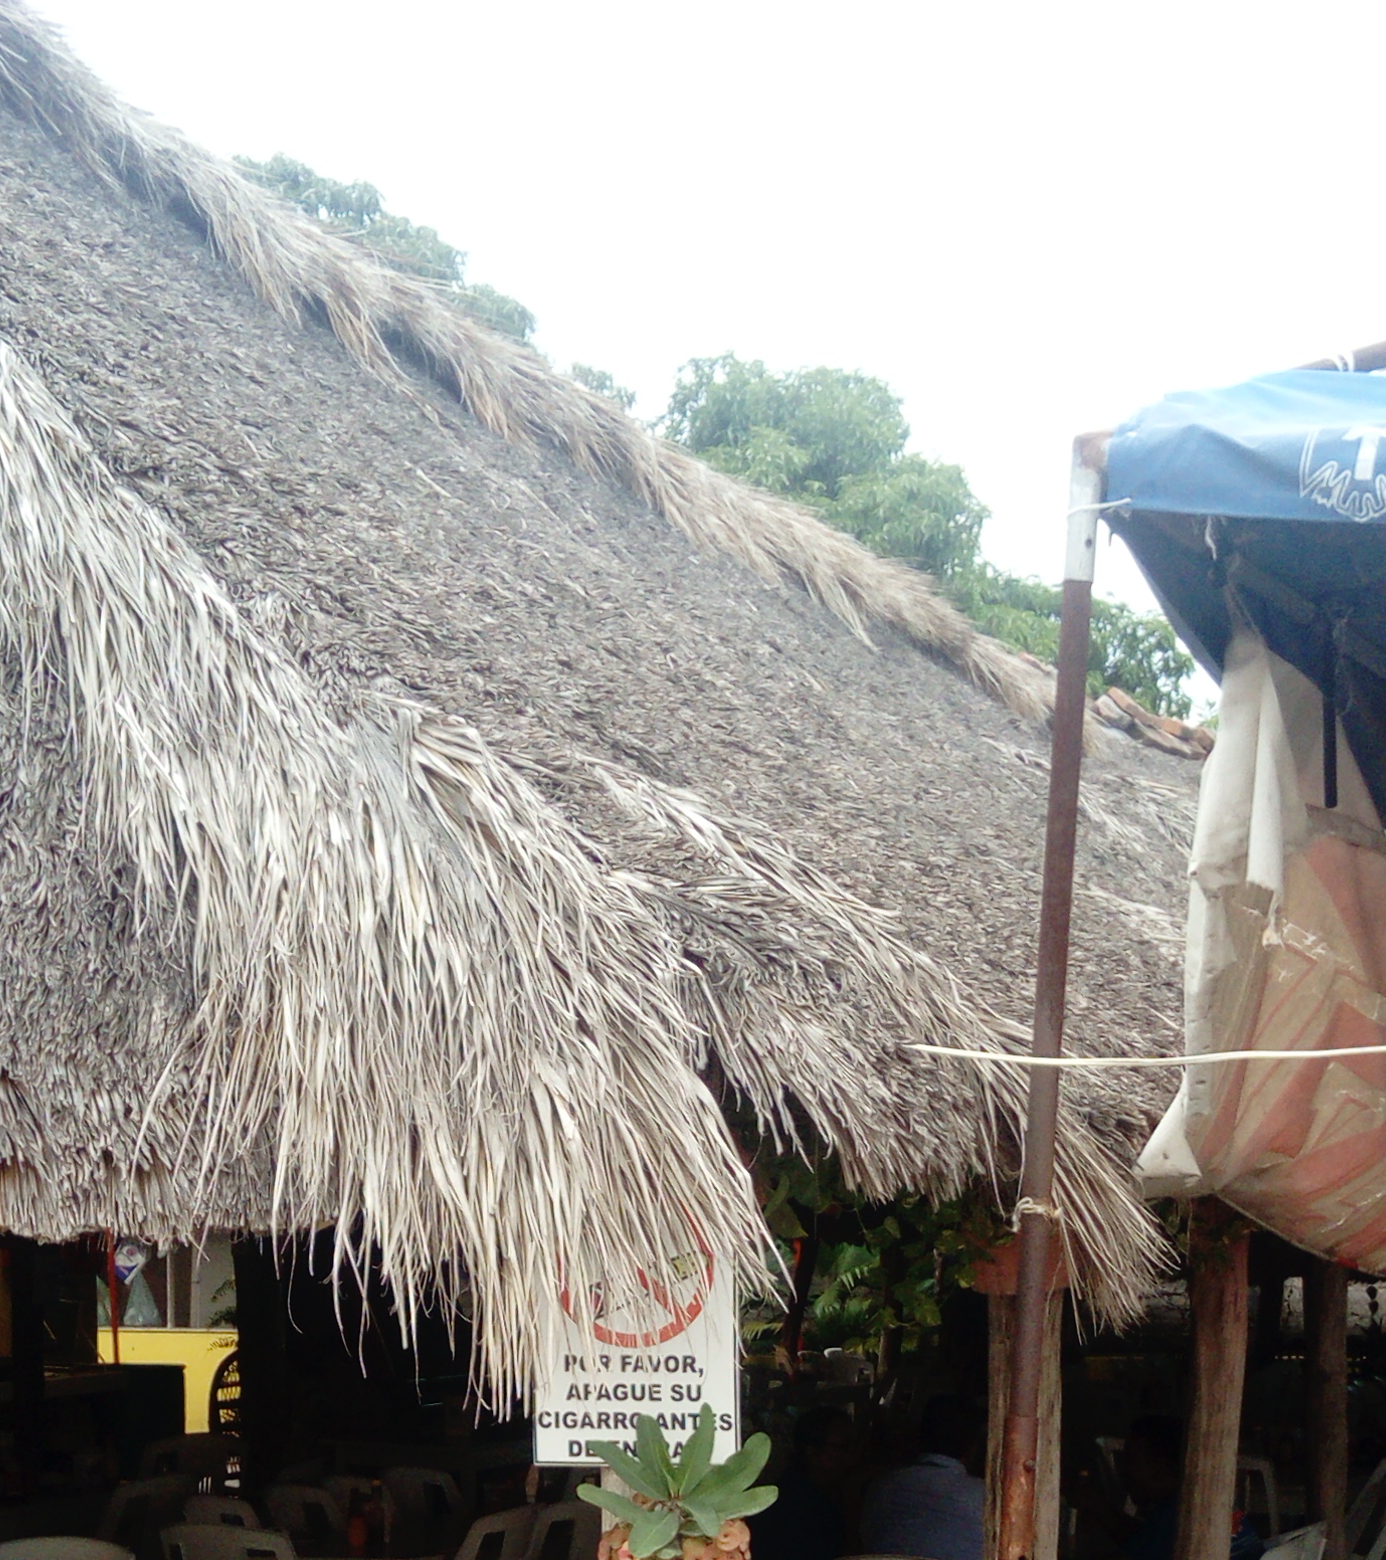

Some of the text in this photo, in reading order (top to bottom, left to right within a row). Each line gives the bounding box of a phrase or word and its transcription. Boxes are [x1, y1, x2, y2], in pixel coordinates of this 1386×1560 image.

[620, 1354, 704, 1378] FAVOR,
[670, 1383, 702, 1402] SU
[656, 1411, 733, 1431] ANTS
